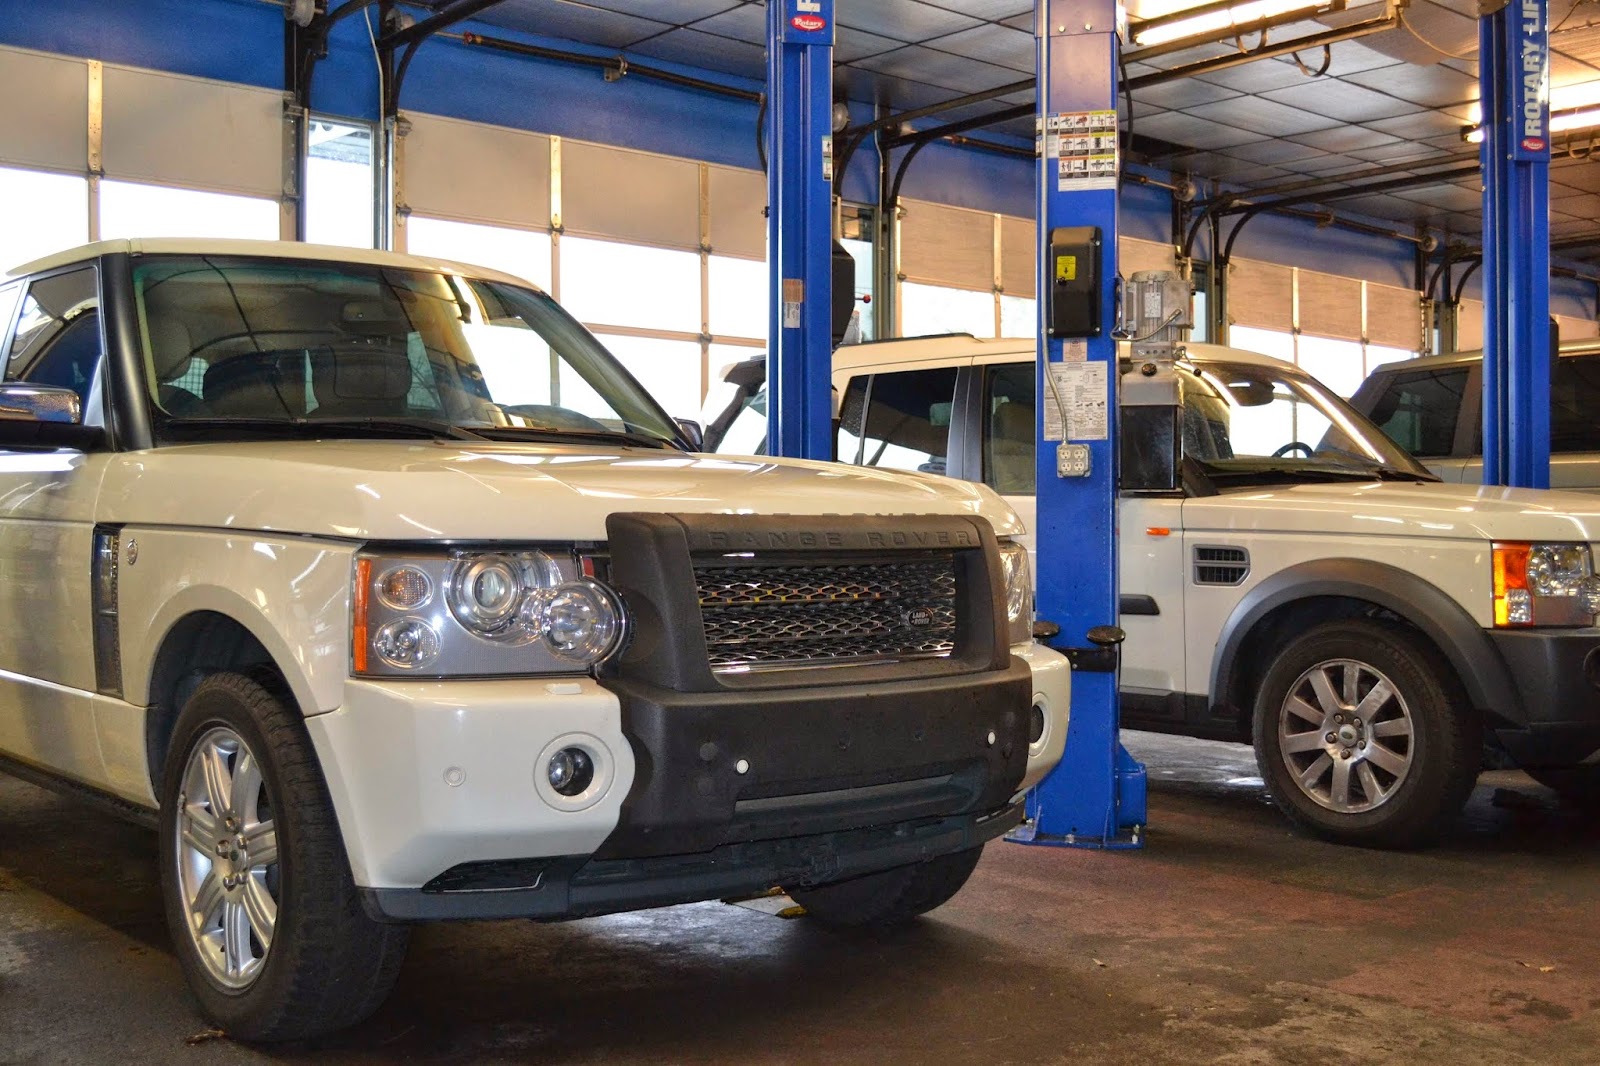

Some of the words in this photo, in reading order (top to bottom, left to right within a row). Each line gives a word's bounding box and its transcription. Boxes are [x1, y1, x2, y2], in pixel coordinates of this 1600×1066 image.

[1522, 0, 1540, 33] LIF
[1523, 39, 1542, 137] ROTARY
[708, 530, 843, 549] RANGE
[866, 530, 974, 547] ROVER
